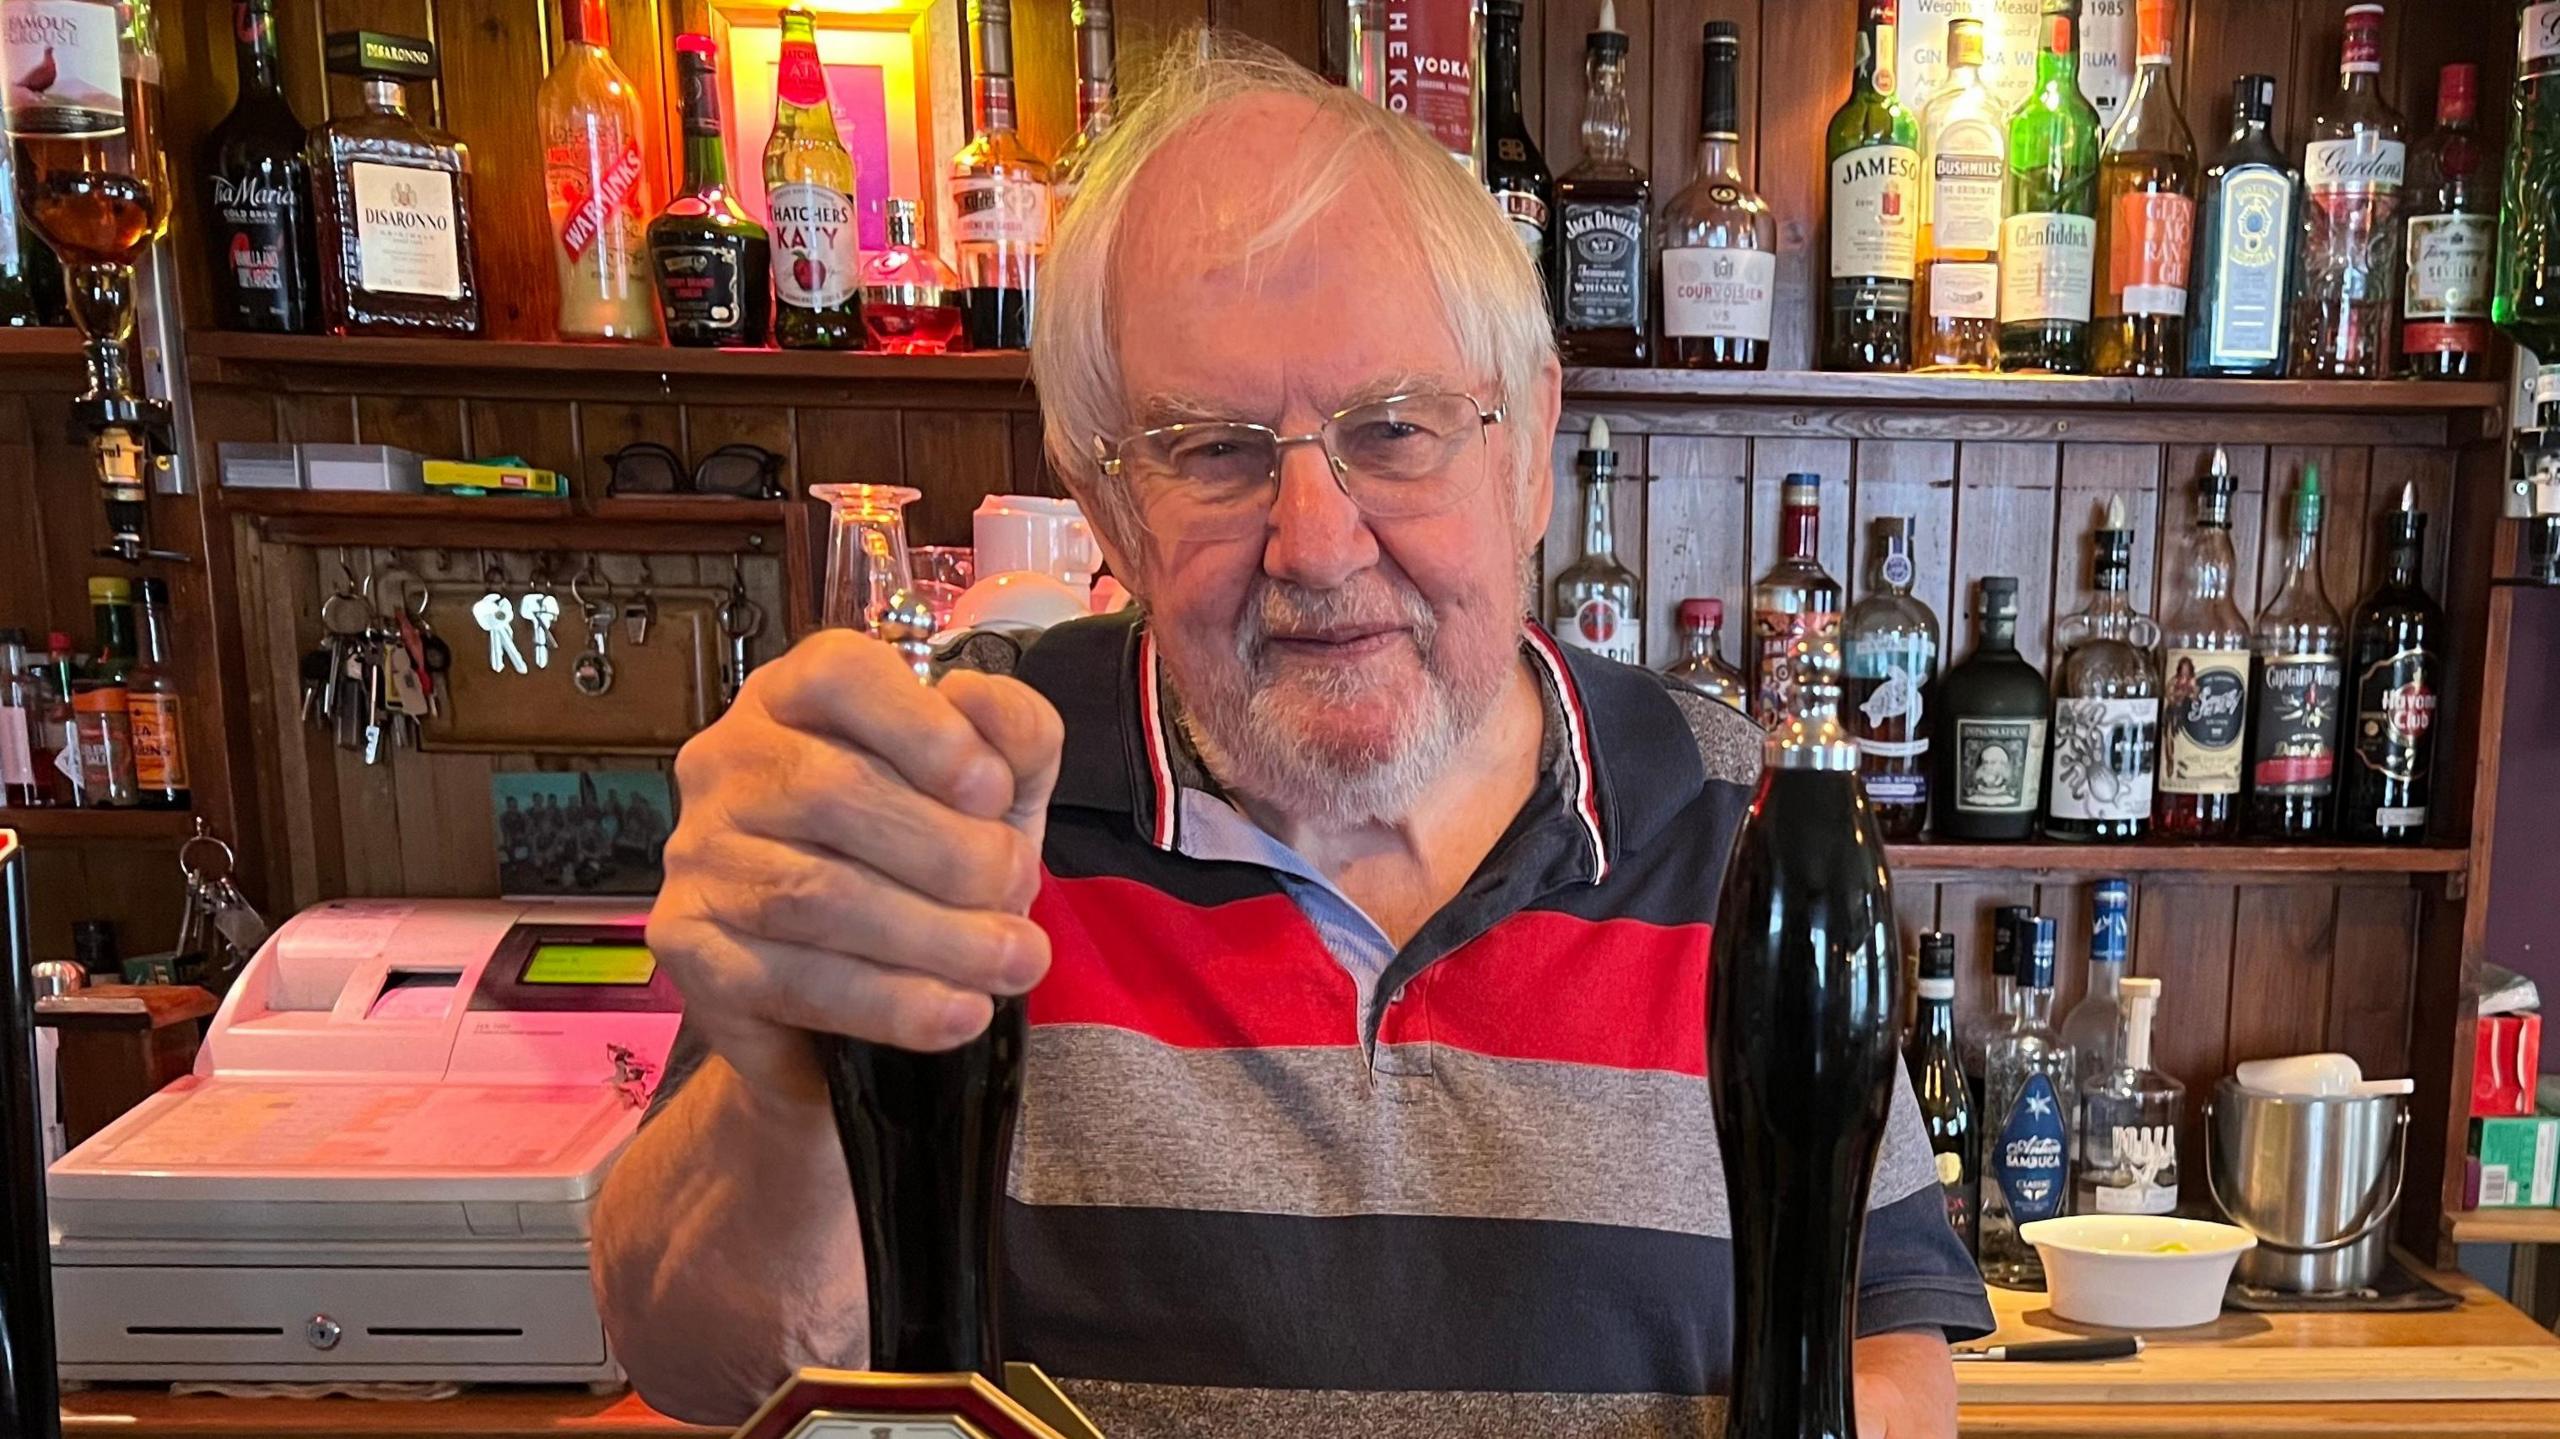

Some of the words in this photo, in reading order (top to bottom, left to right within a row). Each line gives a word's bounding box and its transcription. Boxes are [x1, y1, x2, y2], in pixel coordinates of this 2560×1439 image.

[1993, 2, 2039, 15] Measu
[2090, 2, 2124, 16] 1985
[366, 43, 429, 65] DISARONNO
[1389, 0, 1408, 115] HEKO
[1414, 56, 1471, 80] VODKA
[1936, 160, 2001, 177] BUSHMILLS
[232, 176, 296, 207] Maria
[365, 207, 448, 231] DISARONNO
[1565, 214, 1595, 240] JACK
[2015, 221, 2088, 249] Glenfiddich
[1574, 282, 1631, 294] WHISKEY
[1677, 284, 1763, 300] COURVOISIER
[2006, 1154, 2061, 1169] SAMBUCA
